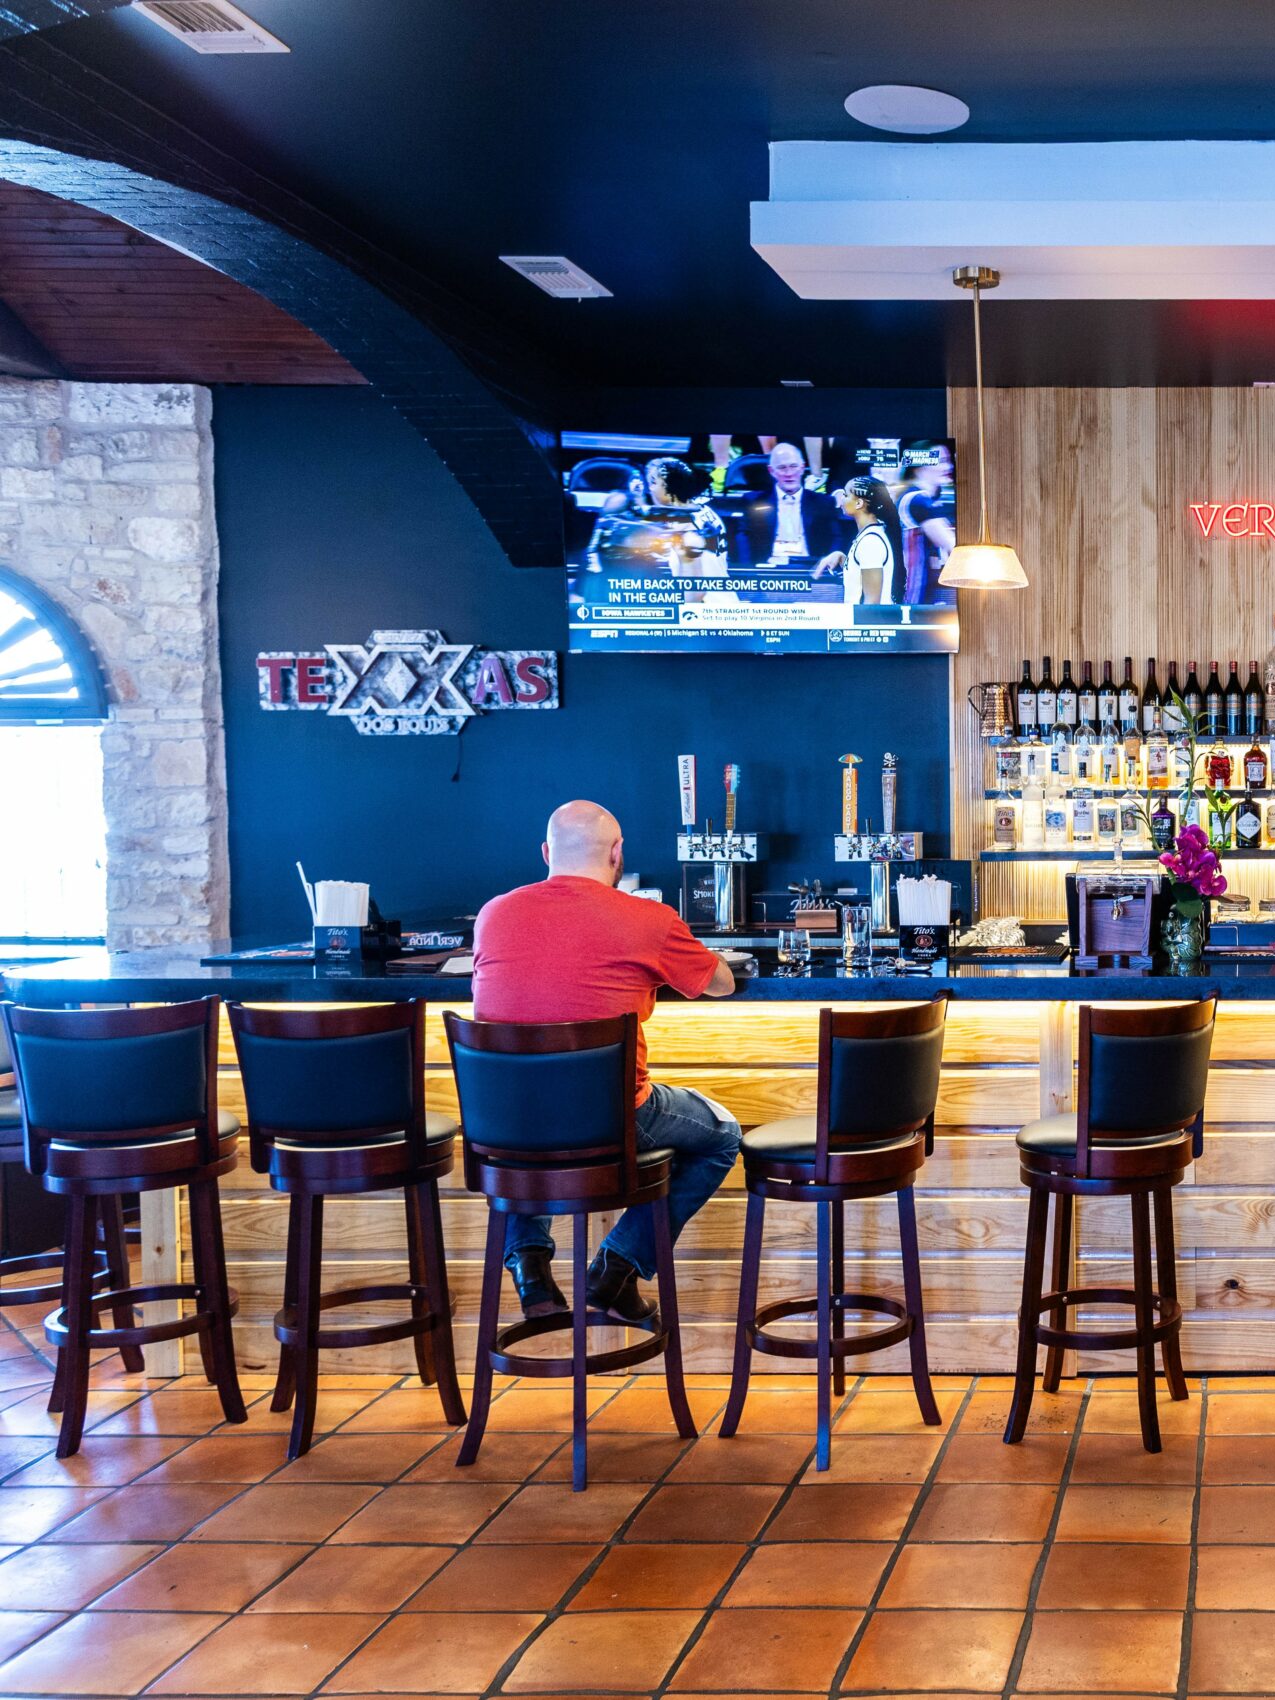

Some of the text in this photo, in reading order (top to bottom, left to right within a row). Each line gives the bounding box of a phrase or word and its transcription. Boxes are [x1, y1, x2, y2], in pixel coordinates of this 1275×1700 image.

[608, 579, 812, 591] THEM BACK TO TAKE SOME CONTROL
[609, 593, 685, 604] IN THE GAME.
[672, 629, 699, 637] Michigan
[723, 629, 754, 637] Oklahoma
[682, 758, 690, 785] ULTRA
[327, 928, 349, 936] Tito's
[913, 926, 936, 935] Tito's
